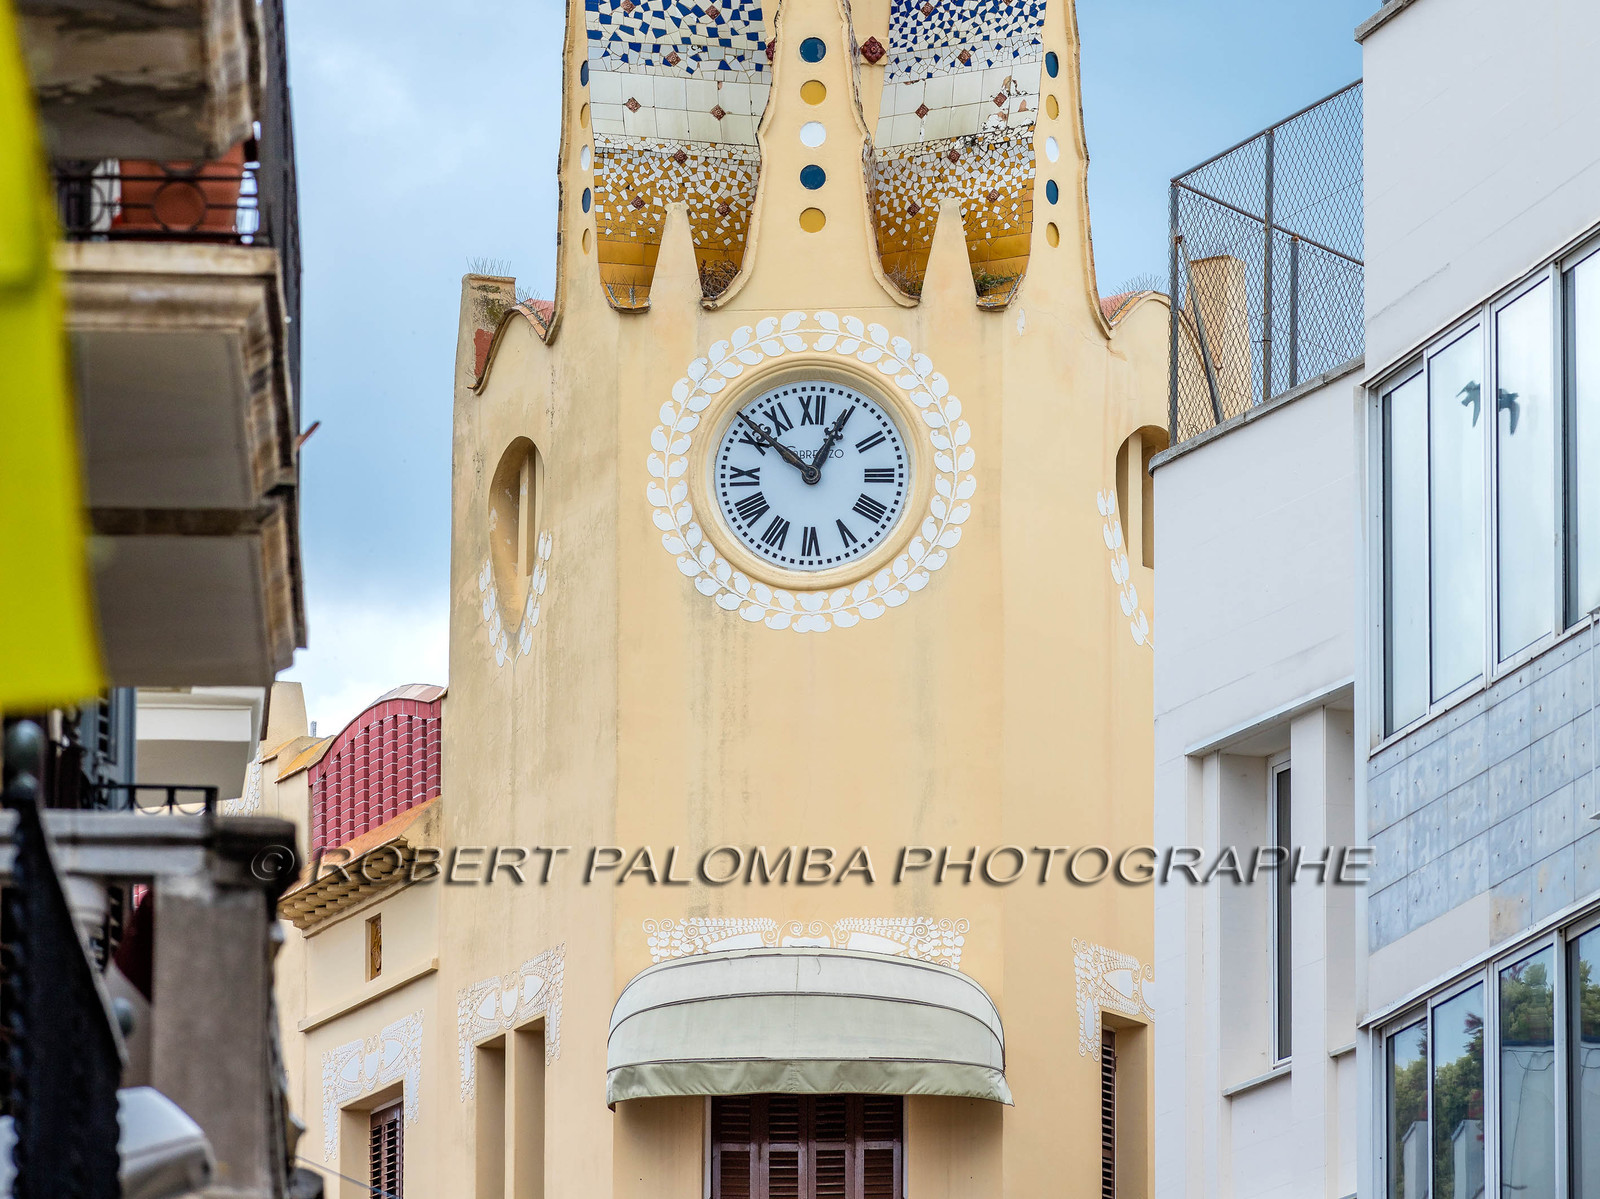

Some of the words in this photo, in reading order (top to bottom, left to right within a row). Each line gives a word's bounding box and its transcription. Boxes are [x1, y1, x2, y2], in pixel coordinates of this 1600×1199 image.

[762, 402, 794, 437] XI
[798, 395, 827, 427] XII
[738, 430, 772, 457] X
[783, 445, 844, 460] BREZO
[855, 430, 887, 454] II
[729, 466, 760, 487] IX
[864, 467, 895, 484] III
[734, 491, 771, 529] VIII
[852, 493, 888, 525] IIII
[760, 515, 791, 551] VII
[801, 526, 821, 557] VI
[836, 518, 858, 549] V
